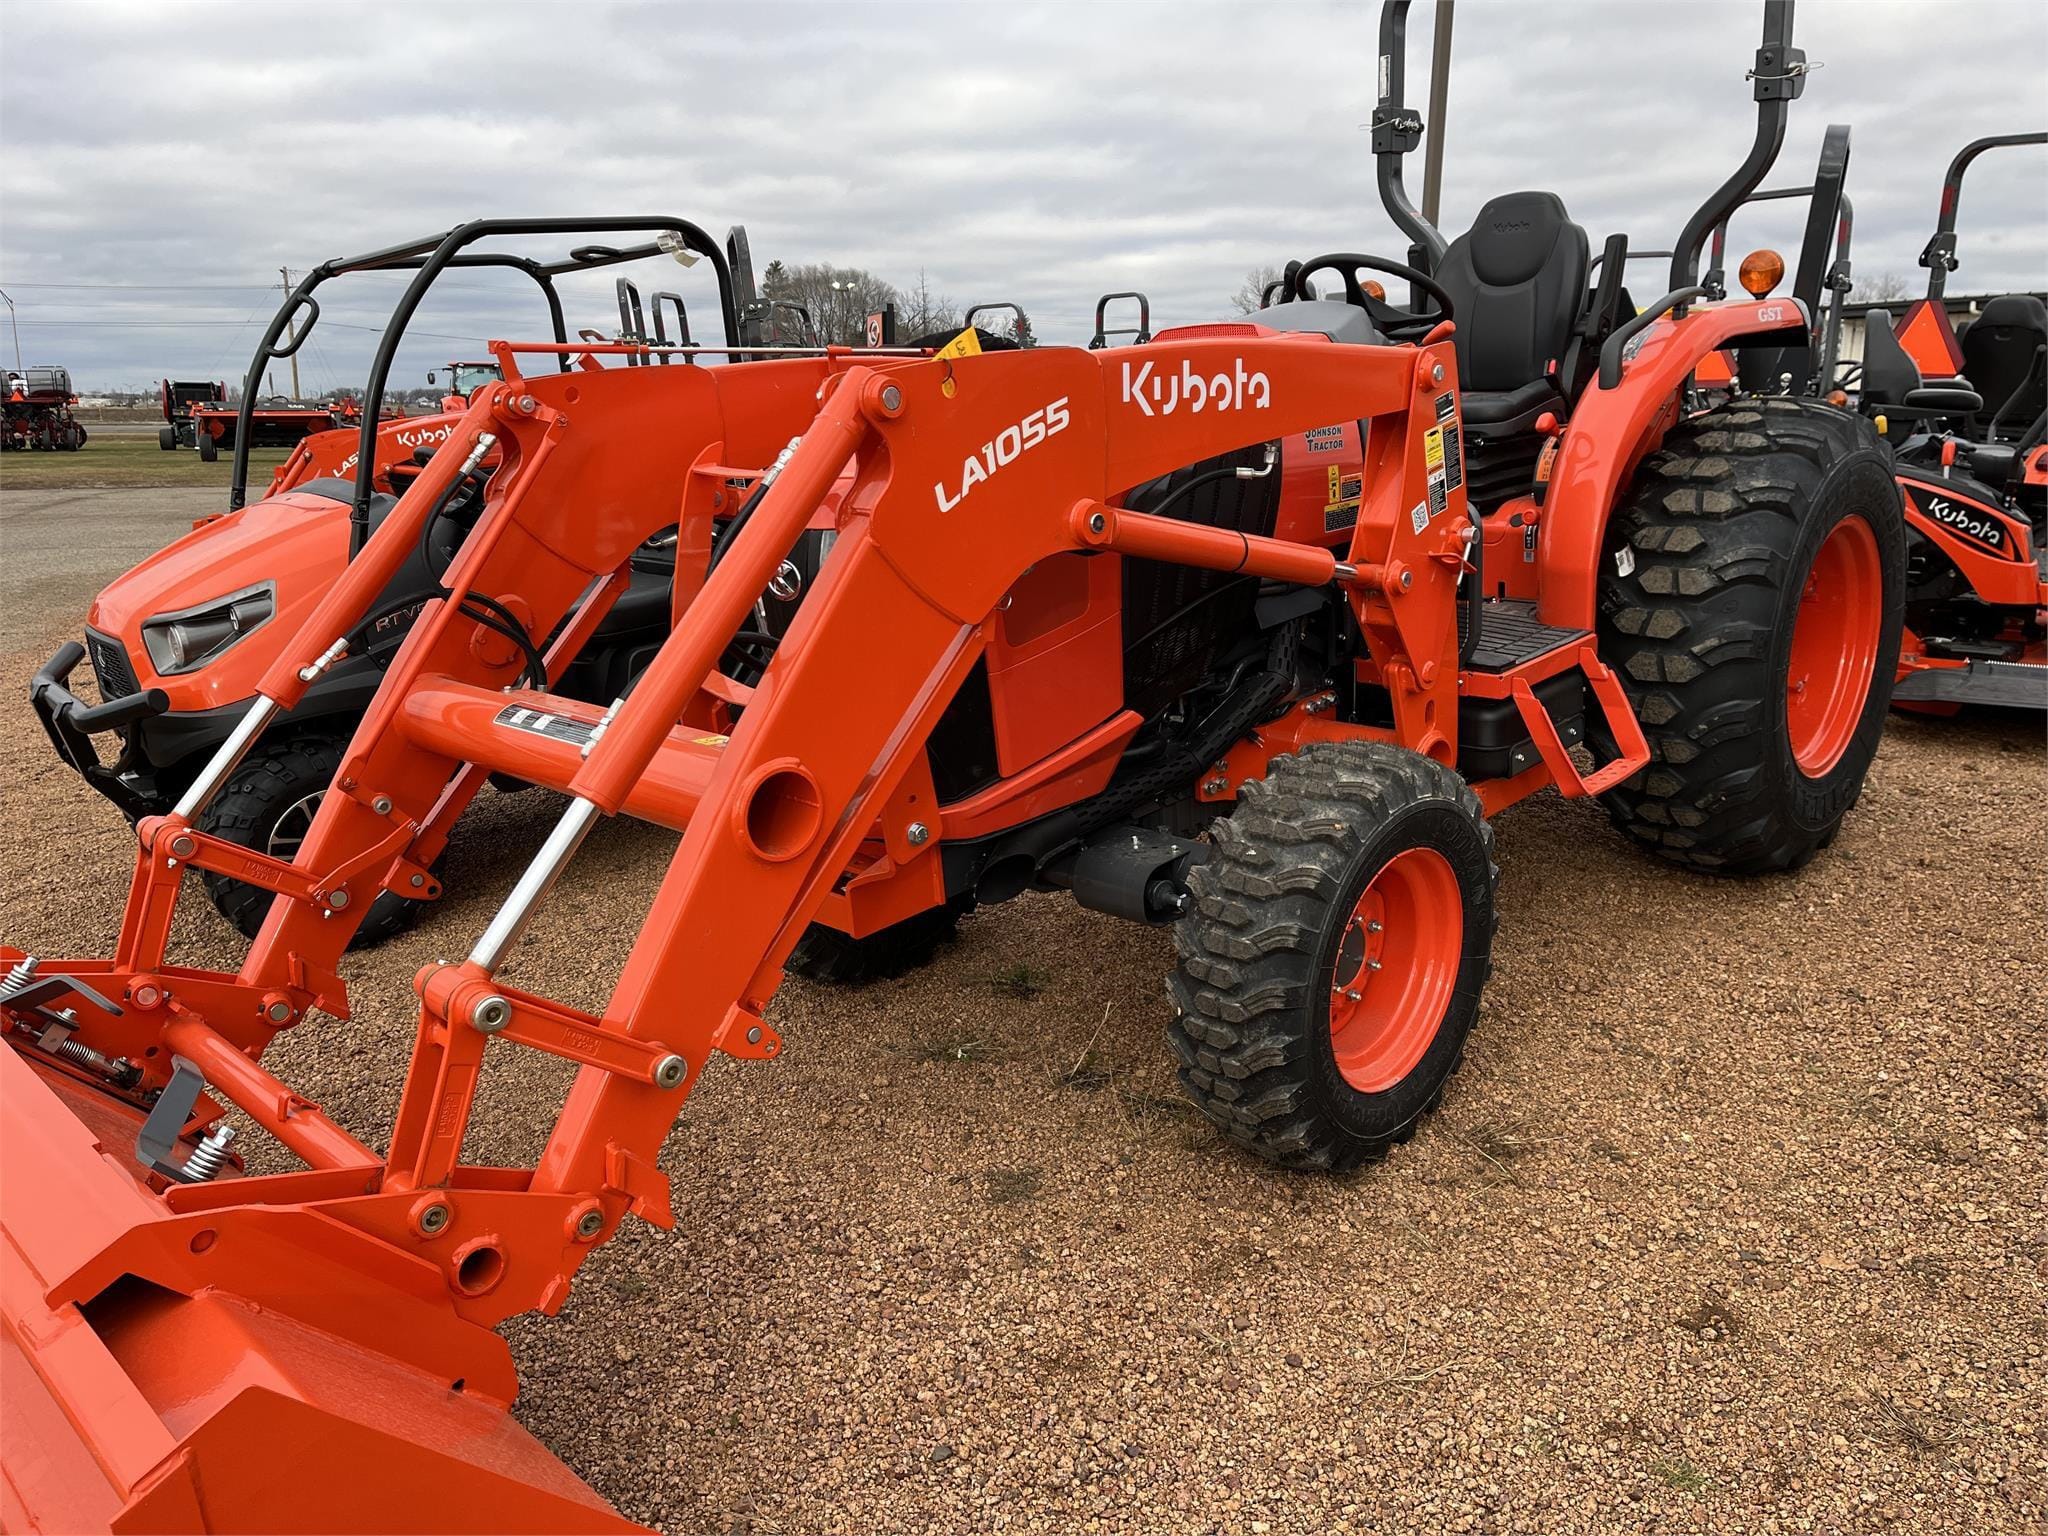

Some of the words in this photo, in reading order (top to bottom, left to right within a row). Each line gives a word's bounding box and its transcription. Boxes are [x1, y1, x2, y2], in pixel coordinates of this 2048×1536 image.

[1758, 306, 1783, 322] GST
[1122, 357, 1270, 416] Kubota
[396, 424, 453, 447] Kubot
[1305, 427, 1342, 439] JOHNSON
[934, 396, 1070, 513] LA1055
[1307, 440, 1343, 452] TRACTOR
[333, 451, 359, 477] LA5
[1928, 498, 1999, 544] Kubota
